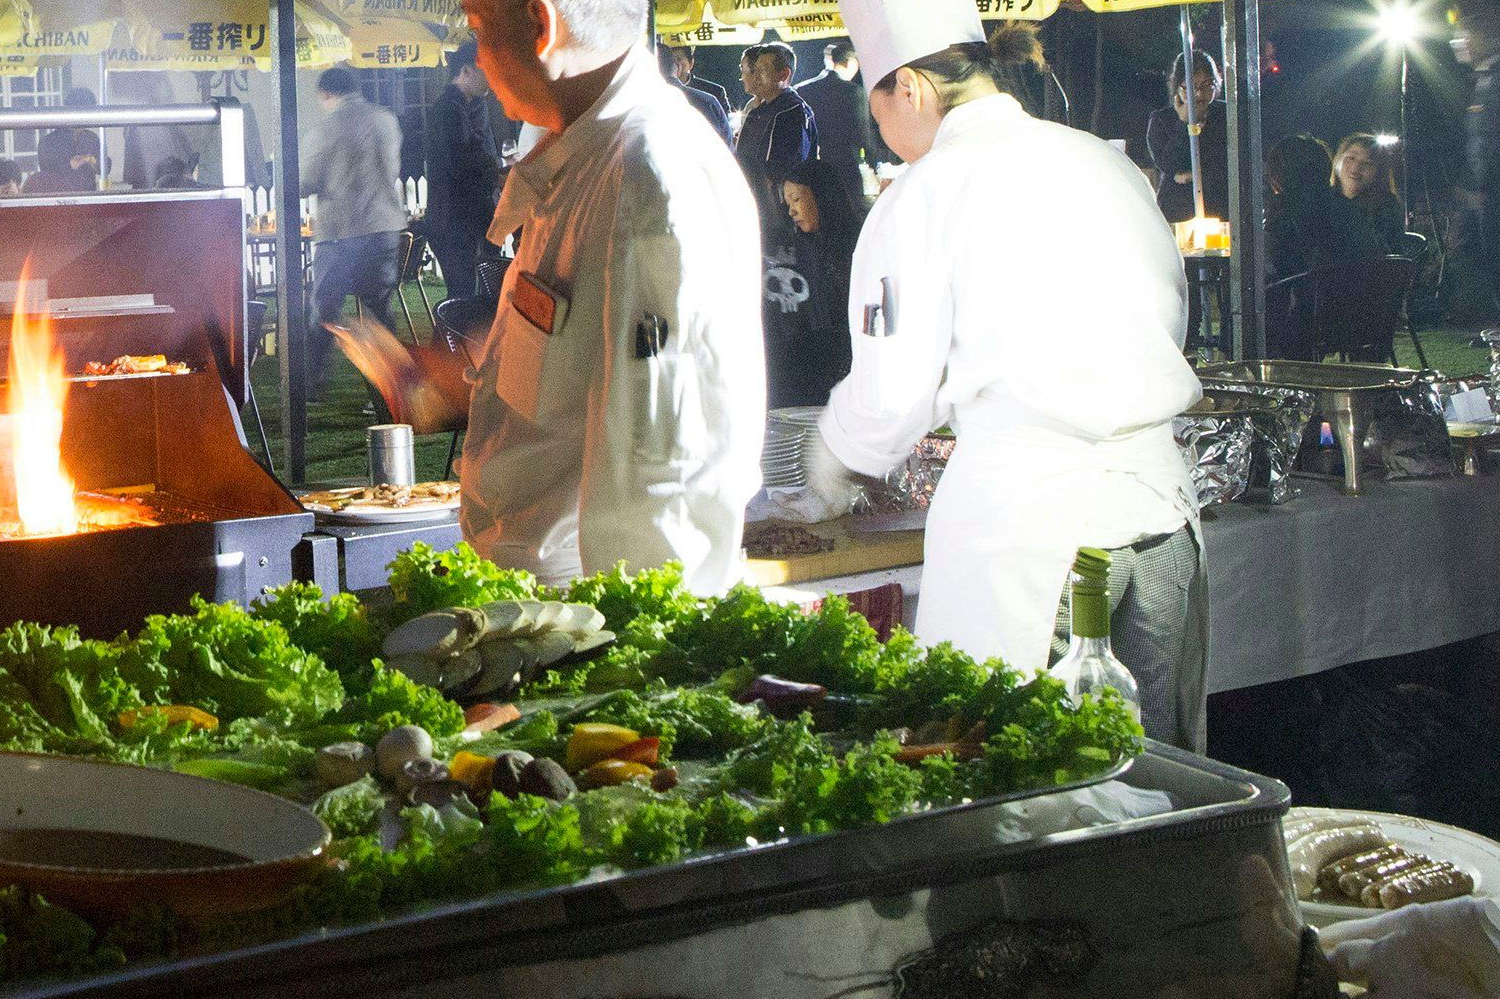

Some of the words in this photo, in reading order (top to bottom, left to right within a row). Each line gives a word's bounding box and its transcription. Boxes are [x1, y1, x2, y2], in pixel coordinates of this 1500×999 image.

[17, 30, 89, 47] CHIBAN
[162, 22, 266, 51] 一番搾り
[361, 44, 420, 64] 一番搾り
